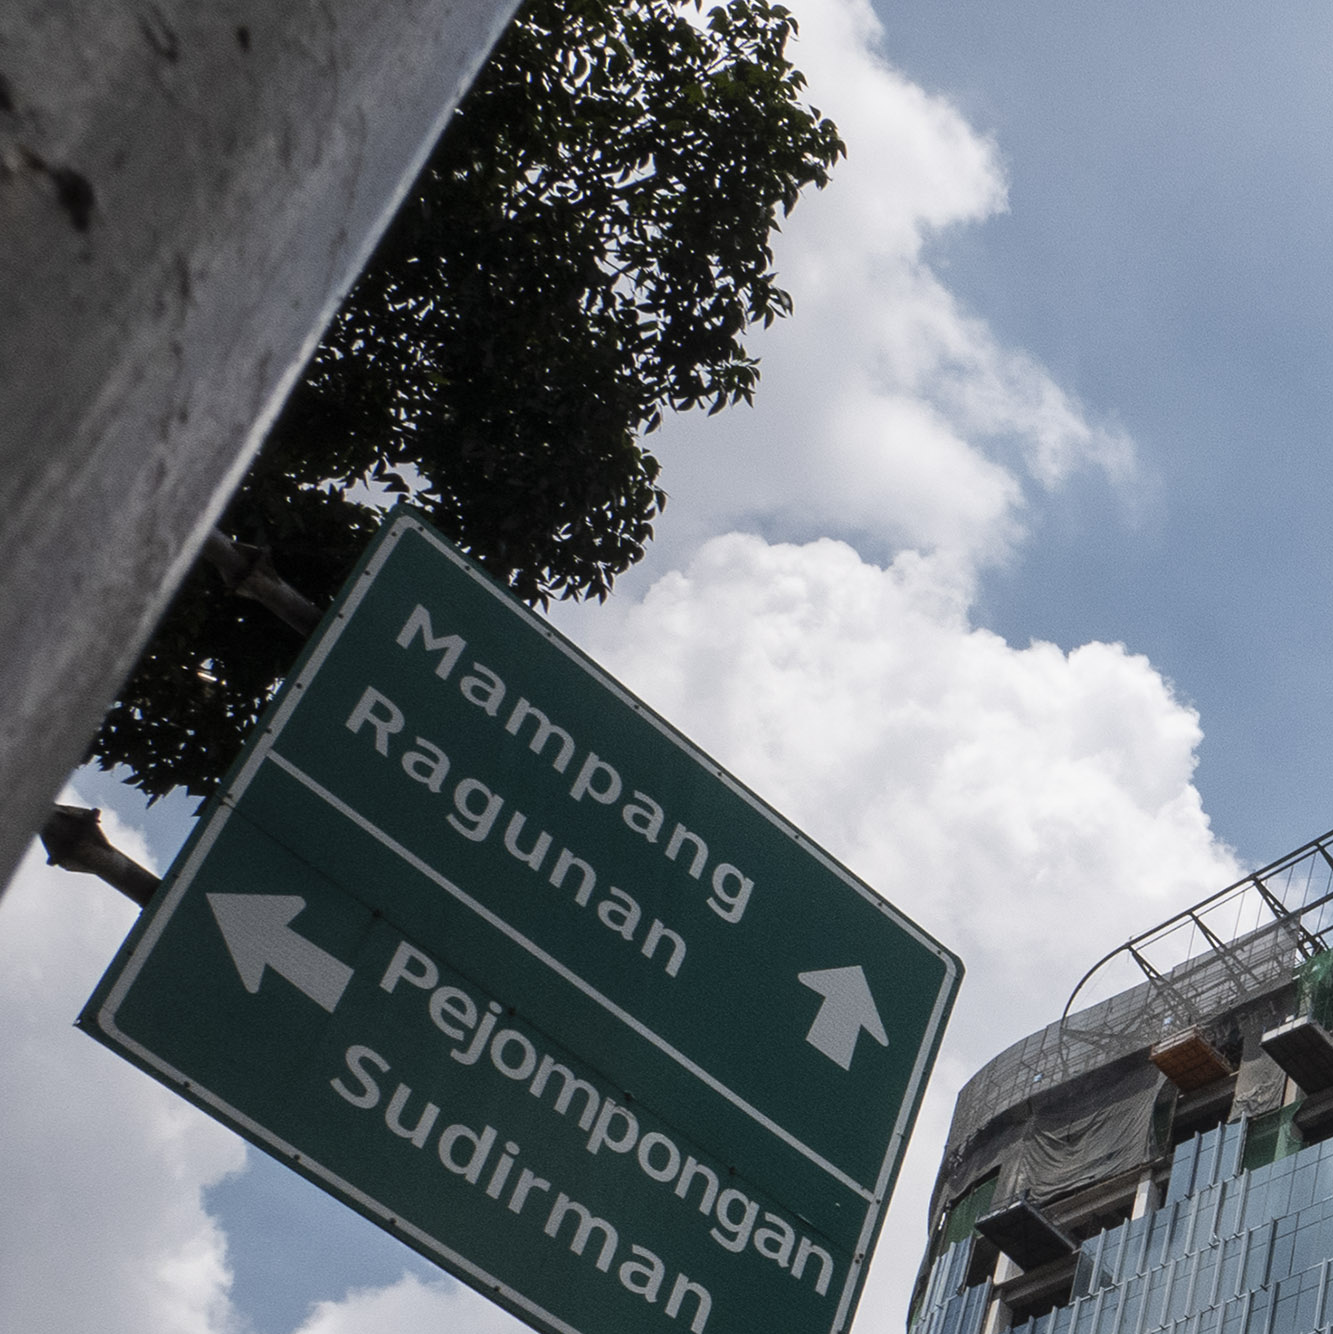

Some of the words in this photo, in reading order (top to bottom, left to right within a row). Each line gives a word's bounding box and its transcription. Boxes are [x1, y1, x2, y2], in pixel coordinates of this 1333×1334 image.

[345, 686, 688, 977] Ragunan
[396, 604, 754, 924] Mampang
[379, 940, 836, 1297] Pejompongan
